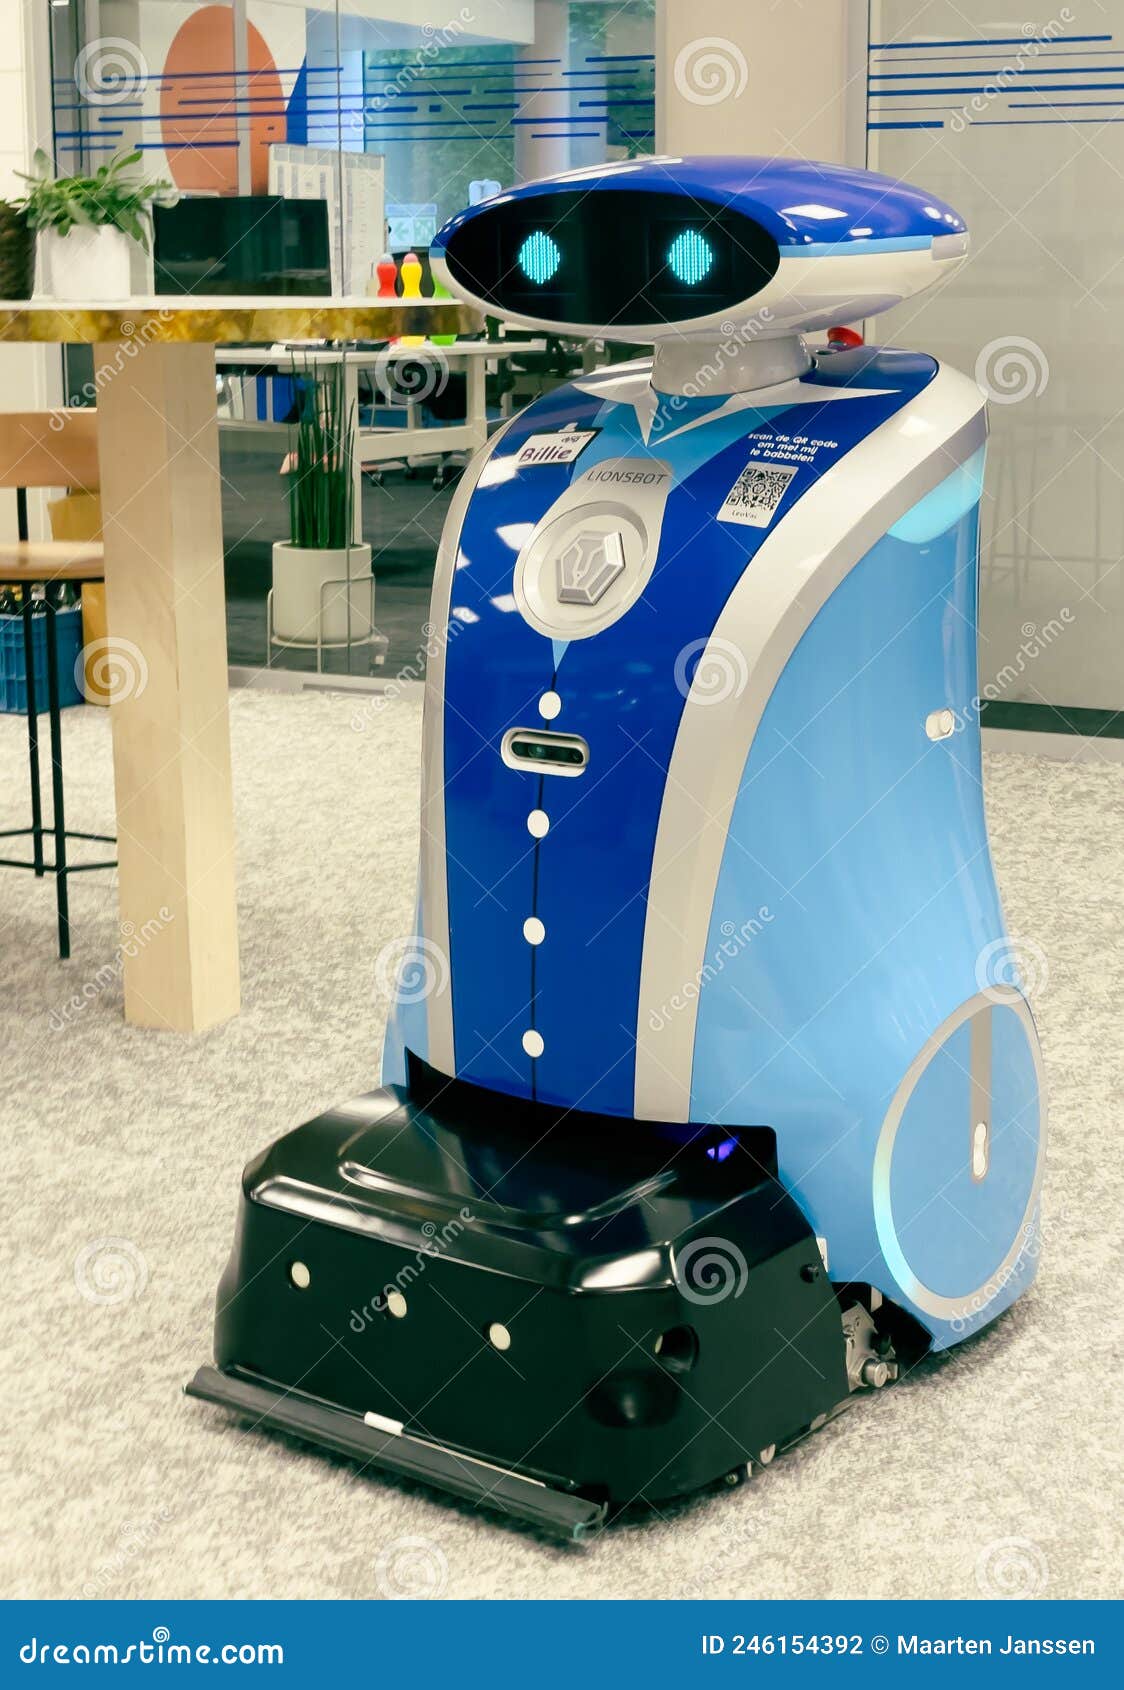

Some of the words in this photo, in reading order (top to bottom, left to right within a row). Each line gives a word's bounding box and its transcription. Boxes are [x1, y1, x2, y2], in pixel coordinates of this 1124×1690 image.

[747, 432, 773, 441] scan
[775, 434, 790, 443] de
[792, 436, 809, 445] QR
[810, 439, 838, 449] code
[757, 441, 775, 449] om
[777, 443, 799, 452] met
[800, 446, 819, 456] mij
[518, 445, 573, 463] Billie
[749, 447, 761, 456] te
[763, 449, 815, 463] babbelen
[586, 470, 669, 486] LIONSBOT
